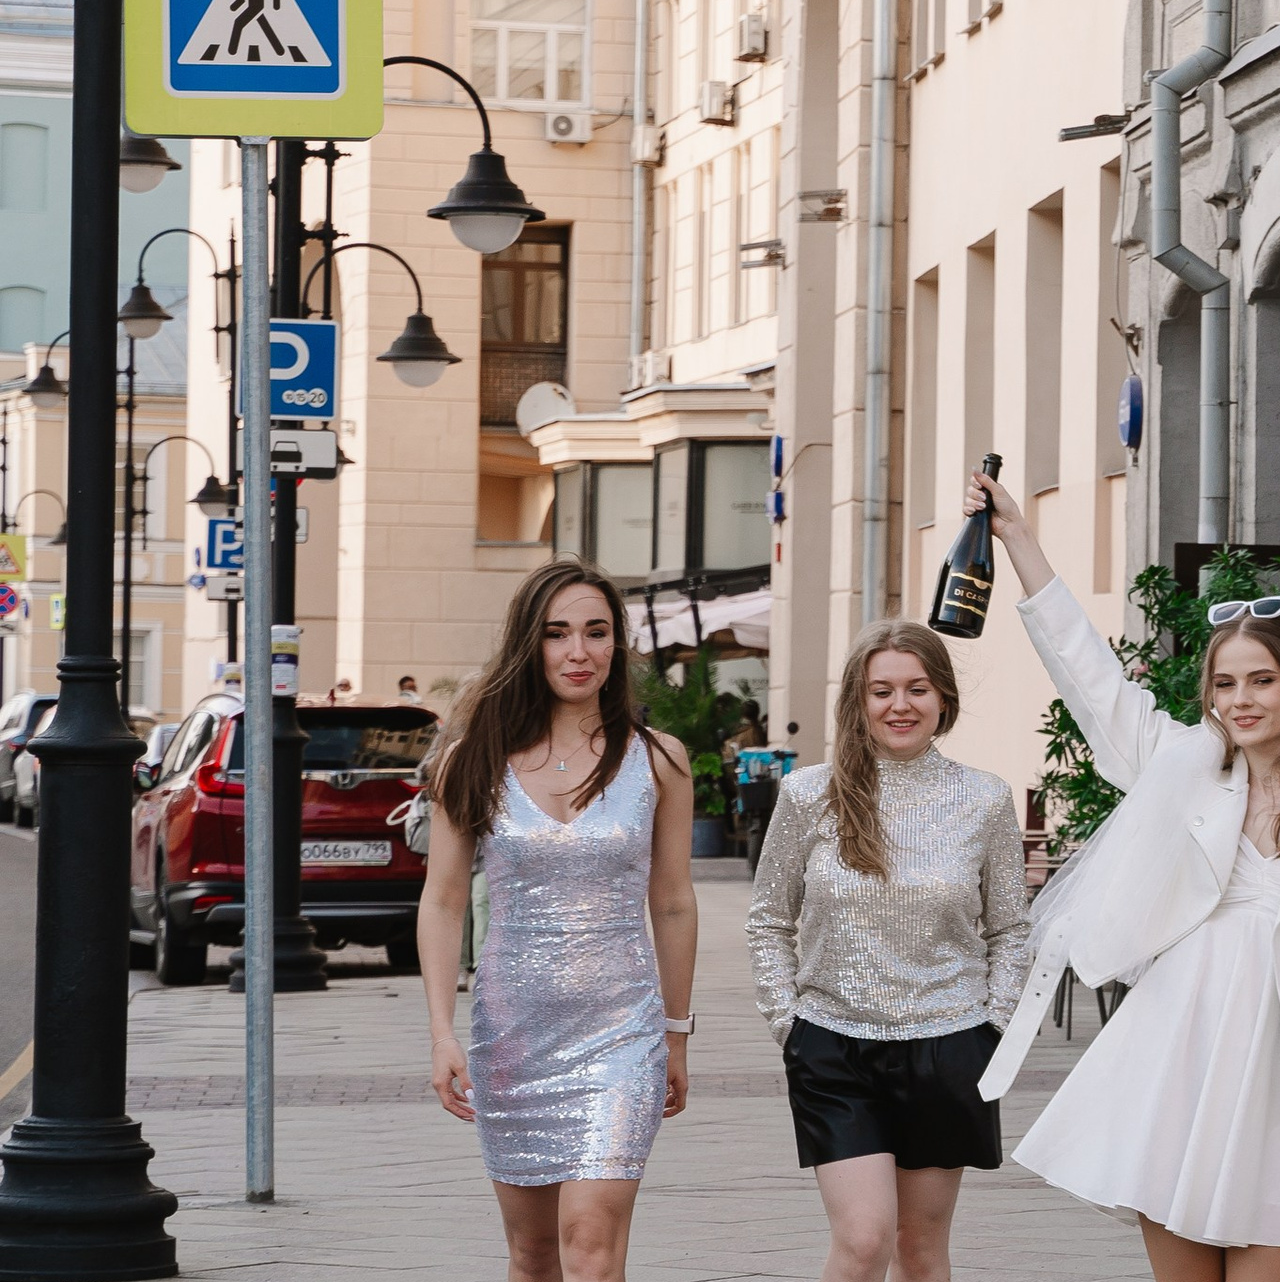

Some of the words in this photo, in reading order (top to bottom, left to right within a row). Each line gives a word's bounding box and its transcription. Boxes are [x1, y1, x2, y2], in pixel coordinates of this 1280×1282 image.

[310, 392, 325, 404] 20
[214, 523, 244, 565] P
[363, 843, 387, 855] 799
